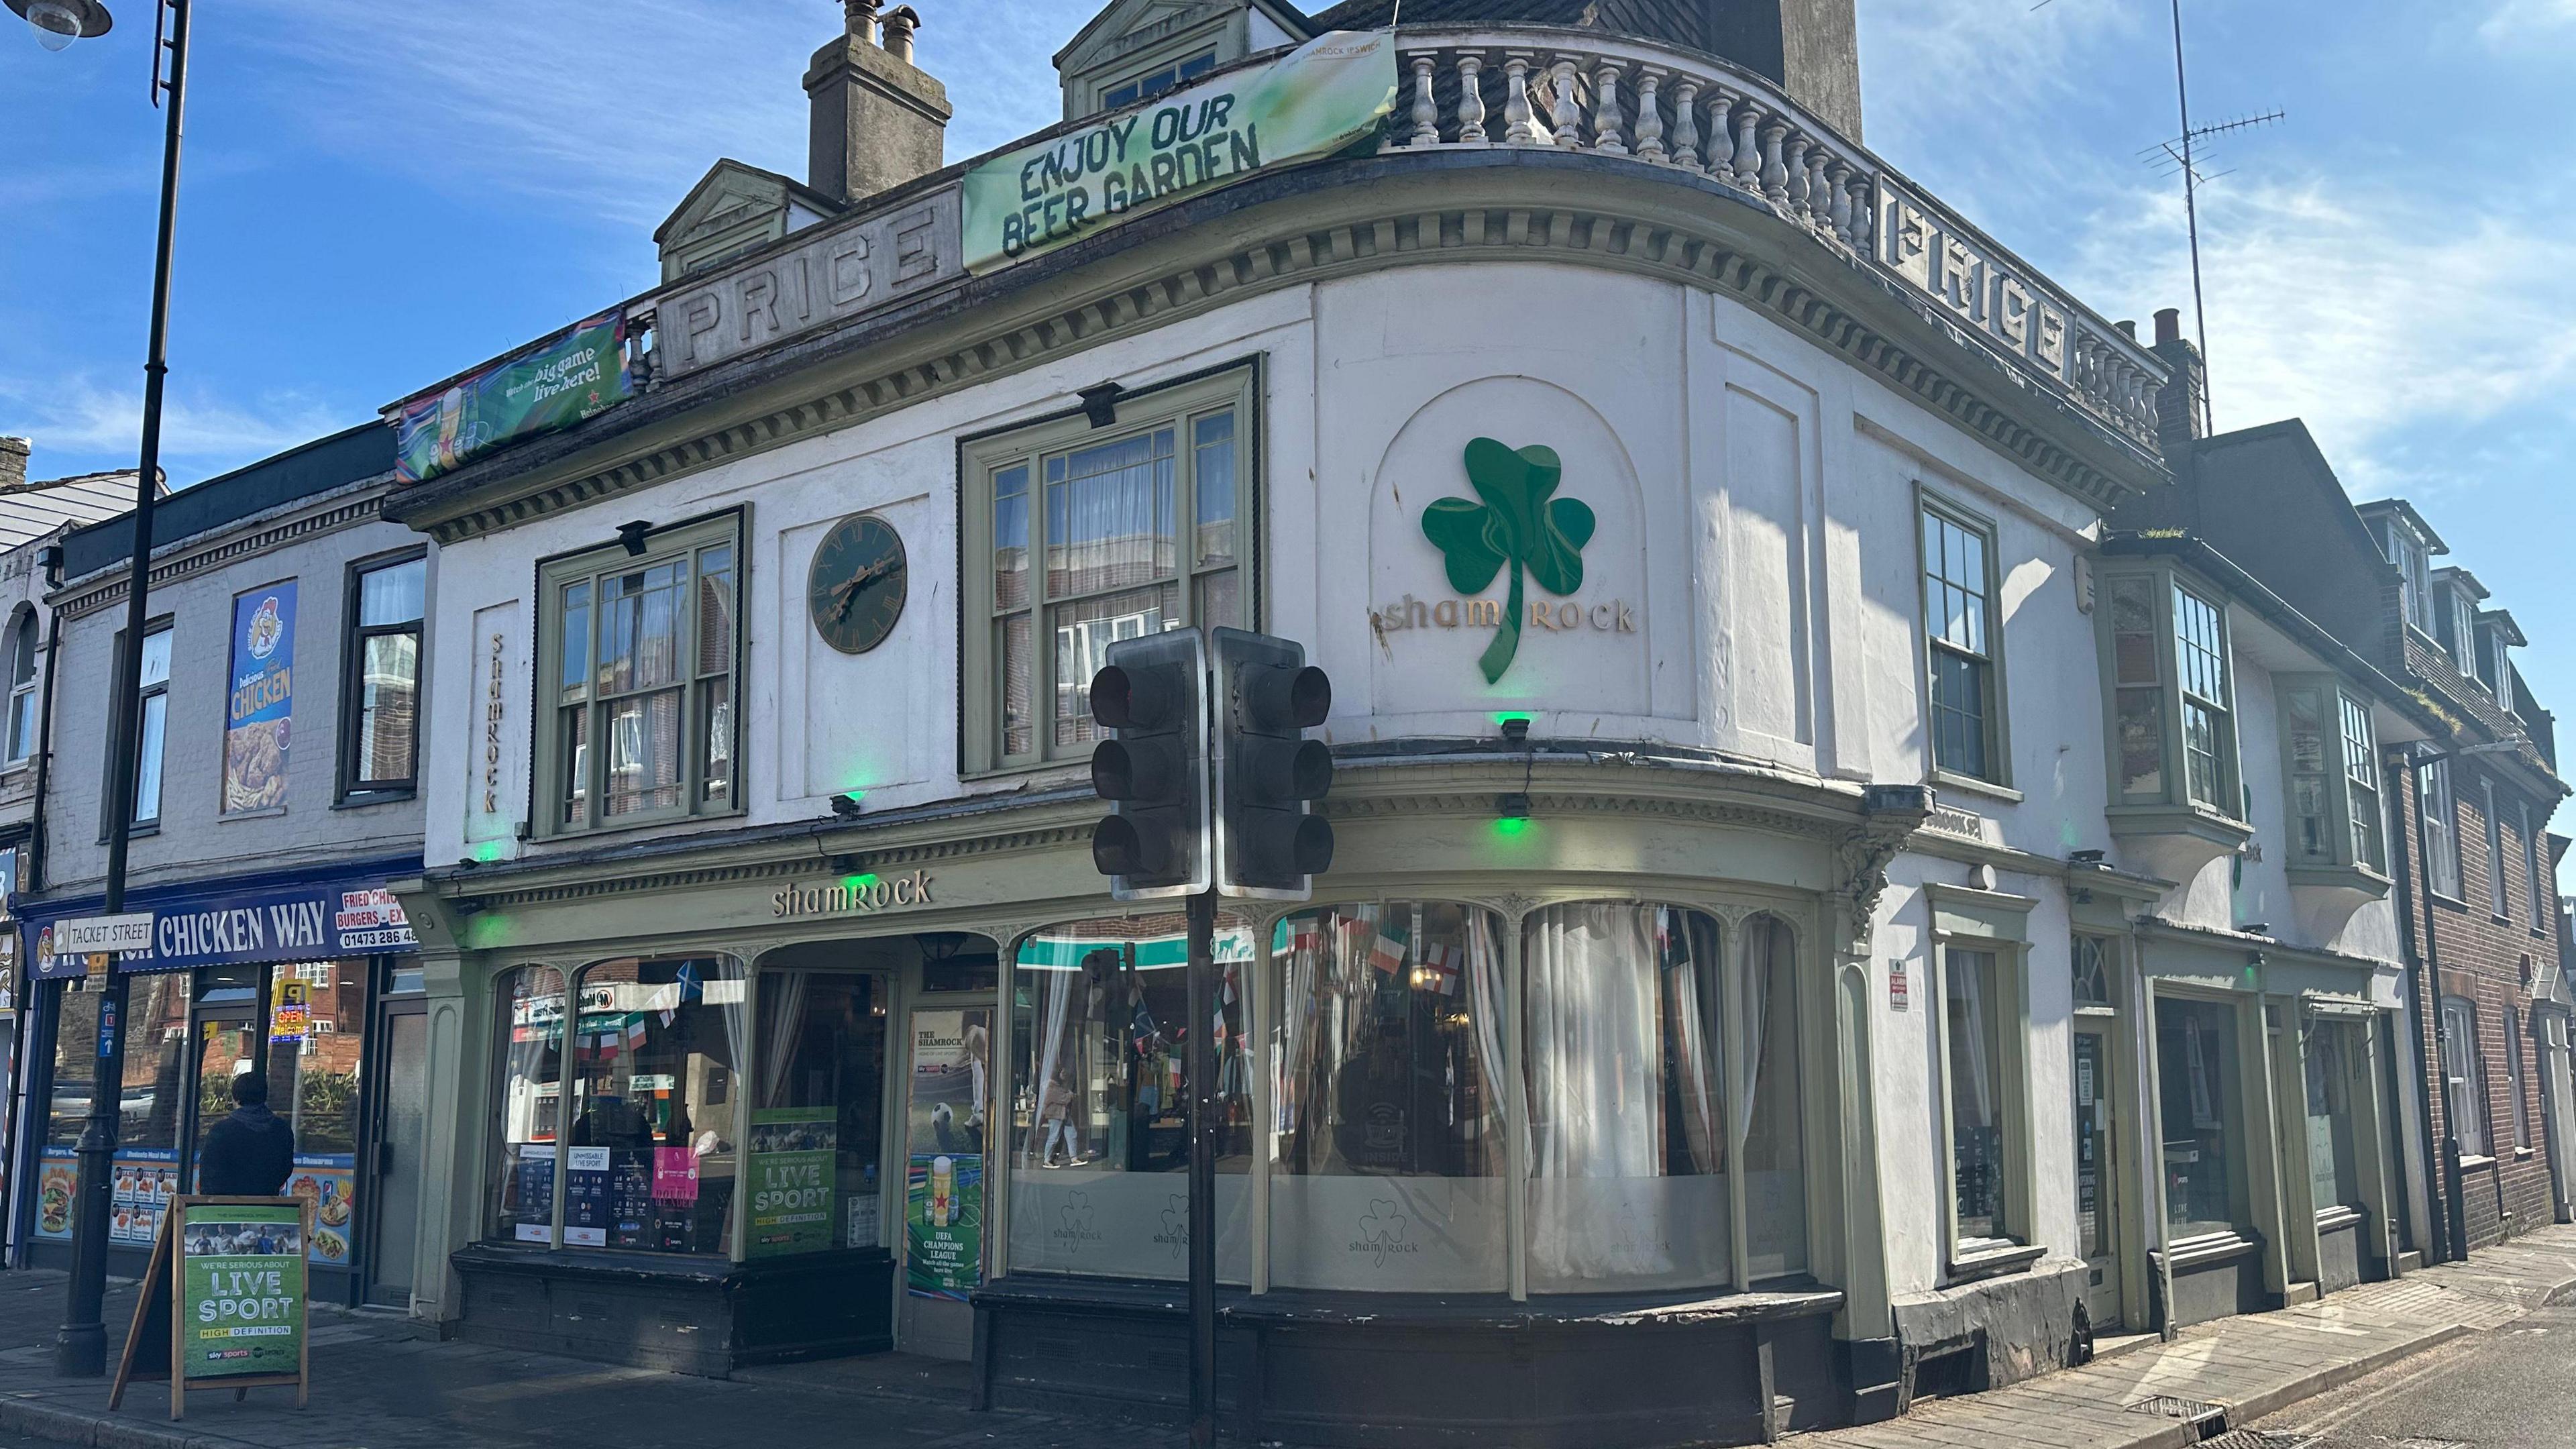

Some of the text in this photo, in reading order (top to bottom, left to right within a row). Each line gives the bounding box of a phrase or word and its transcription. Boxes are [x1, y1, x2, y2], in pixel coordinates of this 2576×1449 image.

[1020, 93, 1236, 201] ENJOY OUR
[1002, 122, 1260, 258] BEER GARDEN
[679, 206, 938, 361] PRICE
[1887, 199, 2065, 372] PRICE
[534, 364, 557, 383] big
[557, 347, 596, 378] game
[533, 362, 600, 402] live here!
[239, 671, 264, 689] Delicious
[231, 667, 292, 721] CHICKEN
[343, 893, 369, 908] FRIED
[159, 901, 325, 957] CHICKEN WAY
[337, 911, 378, 927] BURGERS
[72, 922, 151, 944] TACKET STREET
[344, 933, 376, 947] 01473
[379, 931, 400, 943] 286
[278, 1011, 303, 1023] OPEN
[274, 1024, 307, 1035] Welcome
[765, 1165, 820, 1189] LIVE
[755, 1187, 829, 1211] SPORT
[780, 1212, 826, 1223] DEFINITION
[924, 1240, 963, 1251] CHAMPIONS
[935, 1232, 953, 1241] UEFA
[930, 1250, 956, 1260] LEAGUE
[211, 1271, 281, 1297] LIVE
[199, 1297, 294, 1322] SPORT
[202, 1326, 289, 1337] HIGH DEFINITION
[209, 1351, 221, 1359] sky
[223, 1350, 248, 1358] sports
